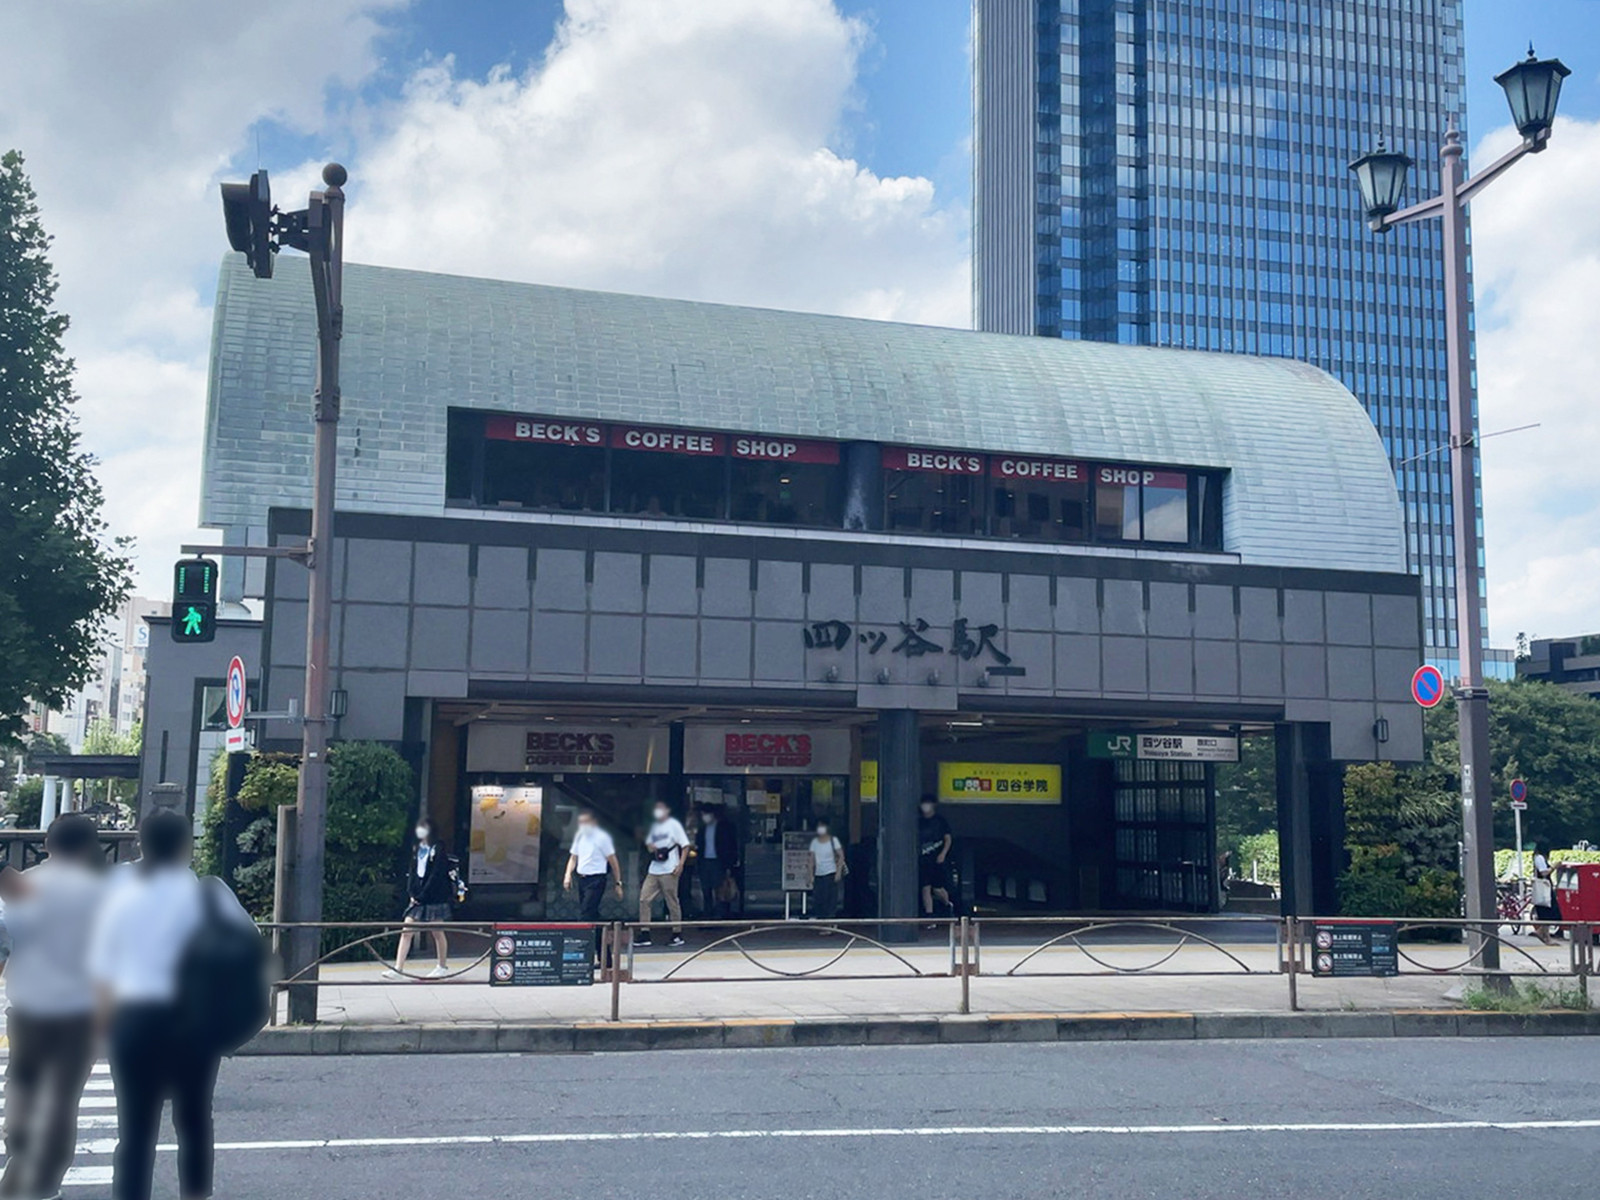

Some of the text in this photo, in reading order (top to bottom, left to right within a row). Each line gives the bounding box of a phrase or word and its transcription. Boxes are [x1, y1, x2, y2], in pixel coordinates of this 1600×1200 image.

[515, 421, 797, 458] BECK'S COFFEE SHOP
[907, 452, 1155, 486] BECK'S COFFEE SHOP
[803, 617, 1012, 665] 四ツ谷駅
[1107, 736, 1132, 751] JR
[1142, 736, 1183, 749] 四ツ谷駅
[1170, 750, 1193, 758] Station
[996, 778, 1048, 792] 四谷学院
